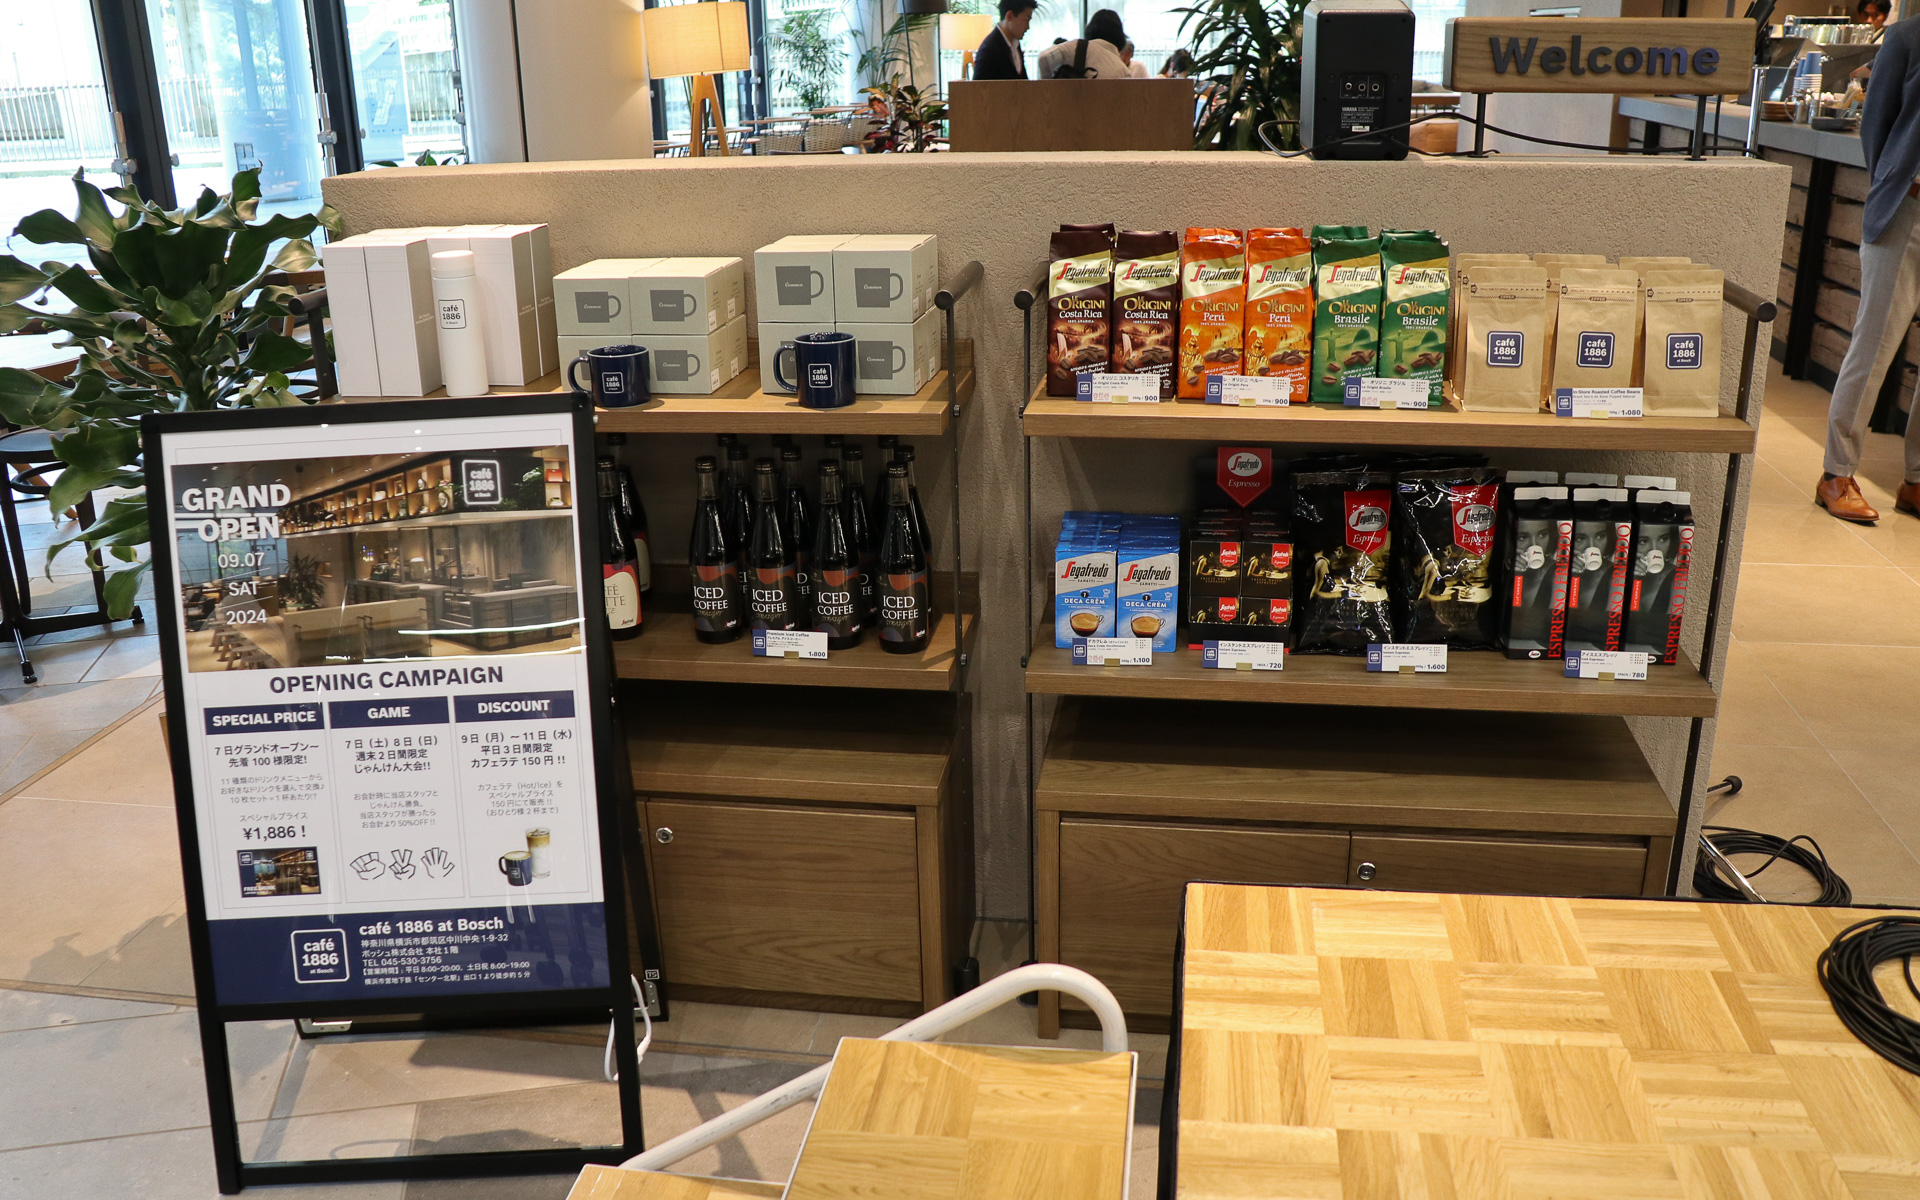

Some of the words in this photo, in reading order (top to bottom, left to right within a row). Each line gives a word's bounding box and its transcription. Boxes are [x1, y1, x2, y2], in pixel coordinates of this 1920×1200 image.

[1489, 35, 1720, 75] Welcome
[1056, 263, 1105, 280] Segafredo
[1122, 263, 1172, 280] Segafredo
[1190, 265, 1240, 282] Segafredo
[1257, 265, 1306, 284] Segafredo
[1327, 265, 1376, 283] Segafredo
[1395, 268, 1445, 284] Segafredo
[1058, 298, 1105, 310] ORIGINI
[1124, 298, 1171, 310] ORIGINI
[1191, 300, 1239, 312] ORIGINI
[1257, 301, 1304, 313] ORIGINI
[1329, 302, 1376, 314] ORIGINI
[1397, 303, 1445, 316] ORIGINI
[1059, 310, 1082, 318] Costa
[1084, 310, 1102, 318] Rica
[1125, 311, 1148, 319] Costa
[1149, 311, 1168, 319] Rica
[1203, 312, 1225, 321] Perú
[1269, 314, 1291, 322] Perú
[1334, 315, 1370, 323] Brasile
[1402, 316, 1438, 325] Brasile
[1496, 338, 1515, 347] café
[1587, 339, 1606, 348] café
[1675, 340, 1694, 349] café
[1494, 347, 1516, 356] 1886
[1585, 348, 1607, 356] 1886
[1673, 349, 1695, 358] 1886
[1231, 456, 1259, 471] Segafredo
[470, 468, 492, 479] café
[469, 480, 495, 491] 1886
[1228, 479, 1260, 488] Espresso
[182, 484, 291, 511] GRAND
[198, 516, 280, 542] OPEN
[1353, 534, 1382, 544] Espresso
[1554, 522, 1573, 584] FREDDO
[1611, 525, 1631, 587] FREDDO
[1673, 528, 1695, 590] FREDDO
[218, 552, 265, 568] 09.07
[1061, 561, 1109, 579] Segafredo
[1123, 564, 1171, 582] Segafredo
[229, 581, 259, 597] SAT
[694, 586, 724, 598] ICED
[752, 589, 783, 602] ICED
[818, 591, 850, 604] ICED
[883, 595, 915, 608] ICED
[694, 600, 728, 610] COFFEE
[752, 602, 787, 612] COFFEE
[817, 604, 853, 616] COFFEE
[226, 609, 268, 625] 2024
[882, 609, 918, 620] COFFEE
[1605, 591, 1625, 651] SPRESSO
[1548, 589, 1567, 657] ESPRESSO
[1664, 595, 1686, 664] ESPRESSO
[270, 673, 373, 693] OPENING
[379, 665, 503, 688] CAMPAIGN
[367, 706, 411, 719] GAME
[477, 700, 550, 714] DISCOUNT
[213, 713, 272, 727] SPECIAL
[274, 711, 316, 723] PRICE
[359, 921, 392, 935] café
[396, 920, 433, 934] 1886
[438, 920, 453, 931] at
[458, 916, 503, 931] Bosch
[303, 938, 335, 952] café
[302, 953, 339, 966] 1886
[381, 956, 442, 966] 045-530-3756
